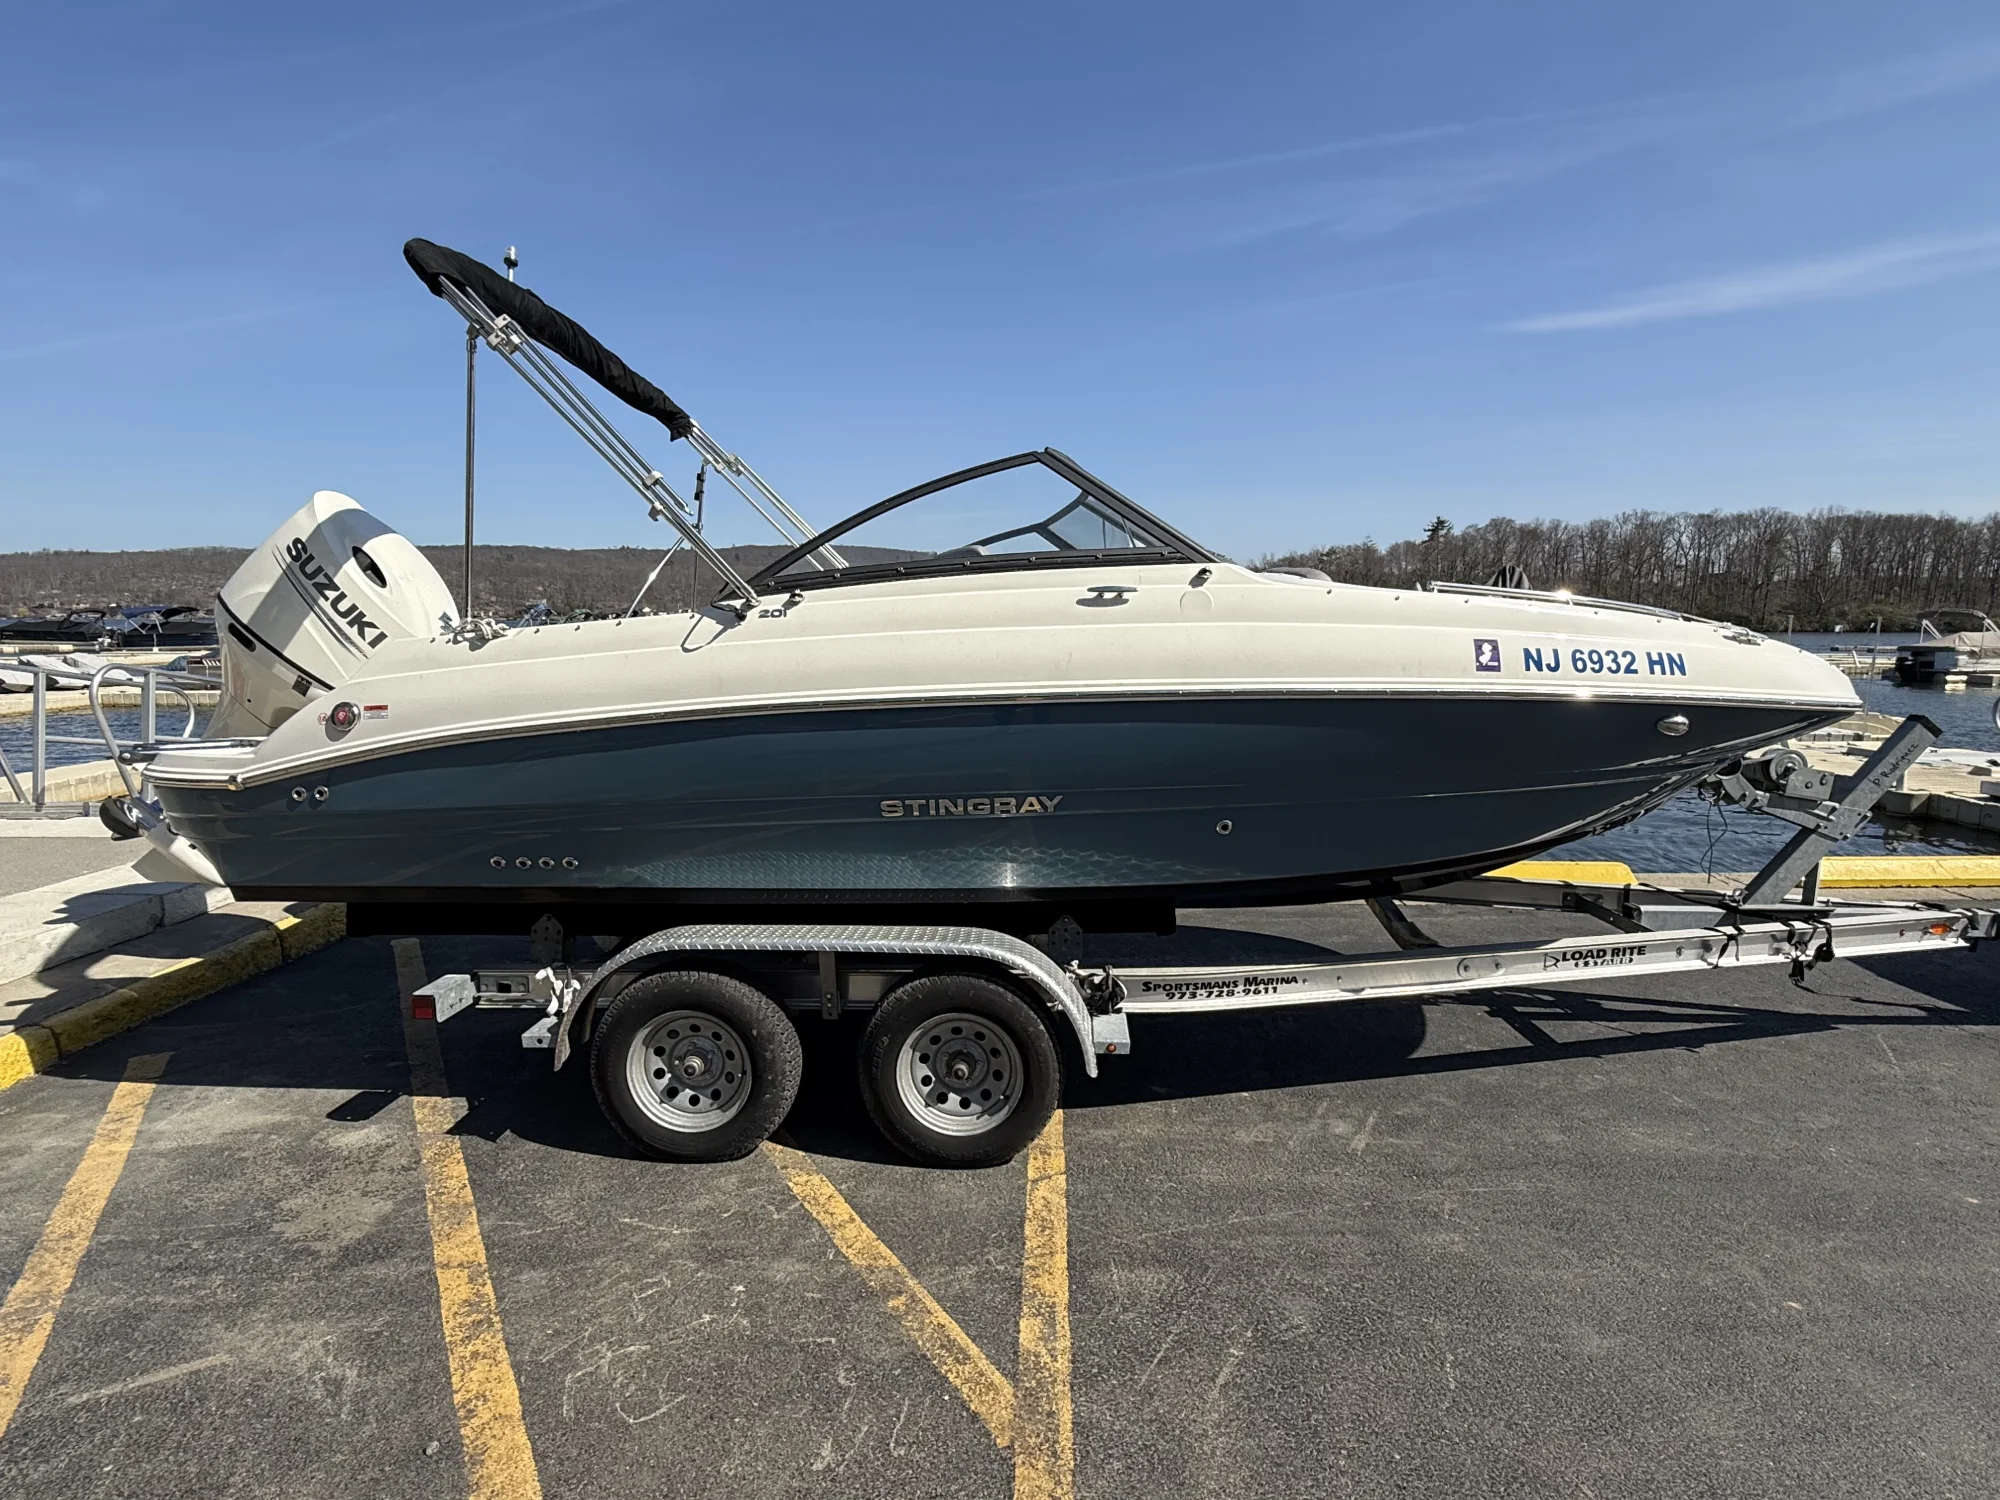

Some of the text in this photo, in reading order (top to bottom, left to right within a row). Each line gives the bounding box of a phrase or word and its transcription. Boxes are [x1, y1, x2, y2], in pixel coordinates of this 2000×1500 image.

[286, 537, 389, 650] SUZUKI
[1523, 648, 1560, 672] NJ
[1571, 649, 1639, 675] 6932
[1646, 652, 1687, 676] HN
[1881, 743, 1919, 778] Rodriguez
[880, 795, 1063, 817] STINGRAY
[1561, 945, 1647, 962] LOAD RITE
[1142, 976, 1298, 992] SPORTSMANS MARINA
[1165, 986, 1278, 1000] 973-728-9611
